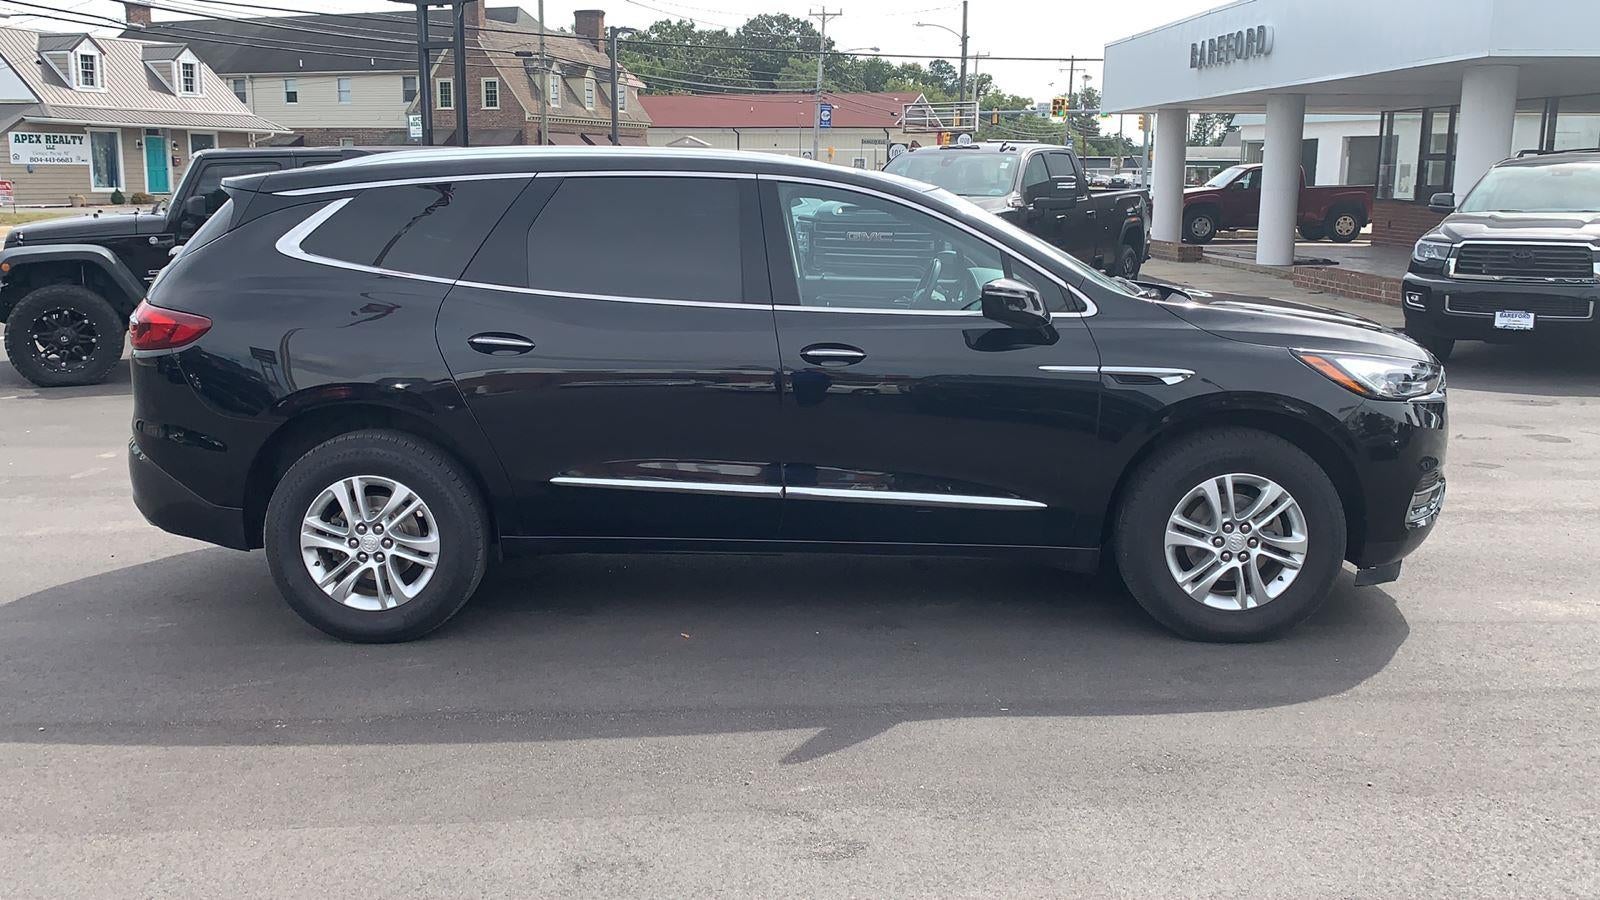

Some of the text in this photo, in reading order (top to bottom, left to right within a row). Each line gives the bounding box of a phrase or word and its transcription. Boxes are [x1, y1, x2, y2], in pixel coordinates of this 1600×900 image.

[1190, 25, 1266, 69] BAREFORD
[14, 134, 84, 145] APEX REALTY
[846, 231, 894, 242] GMC
